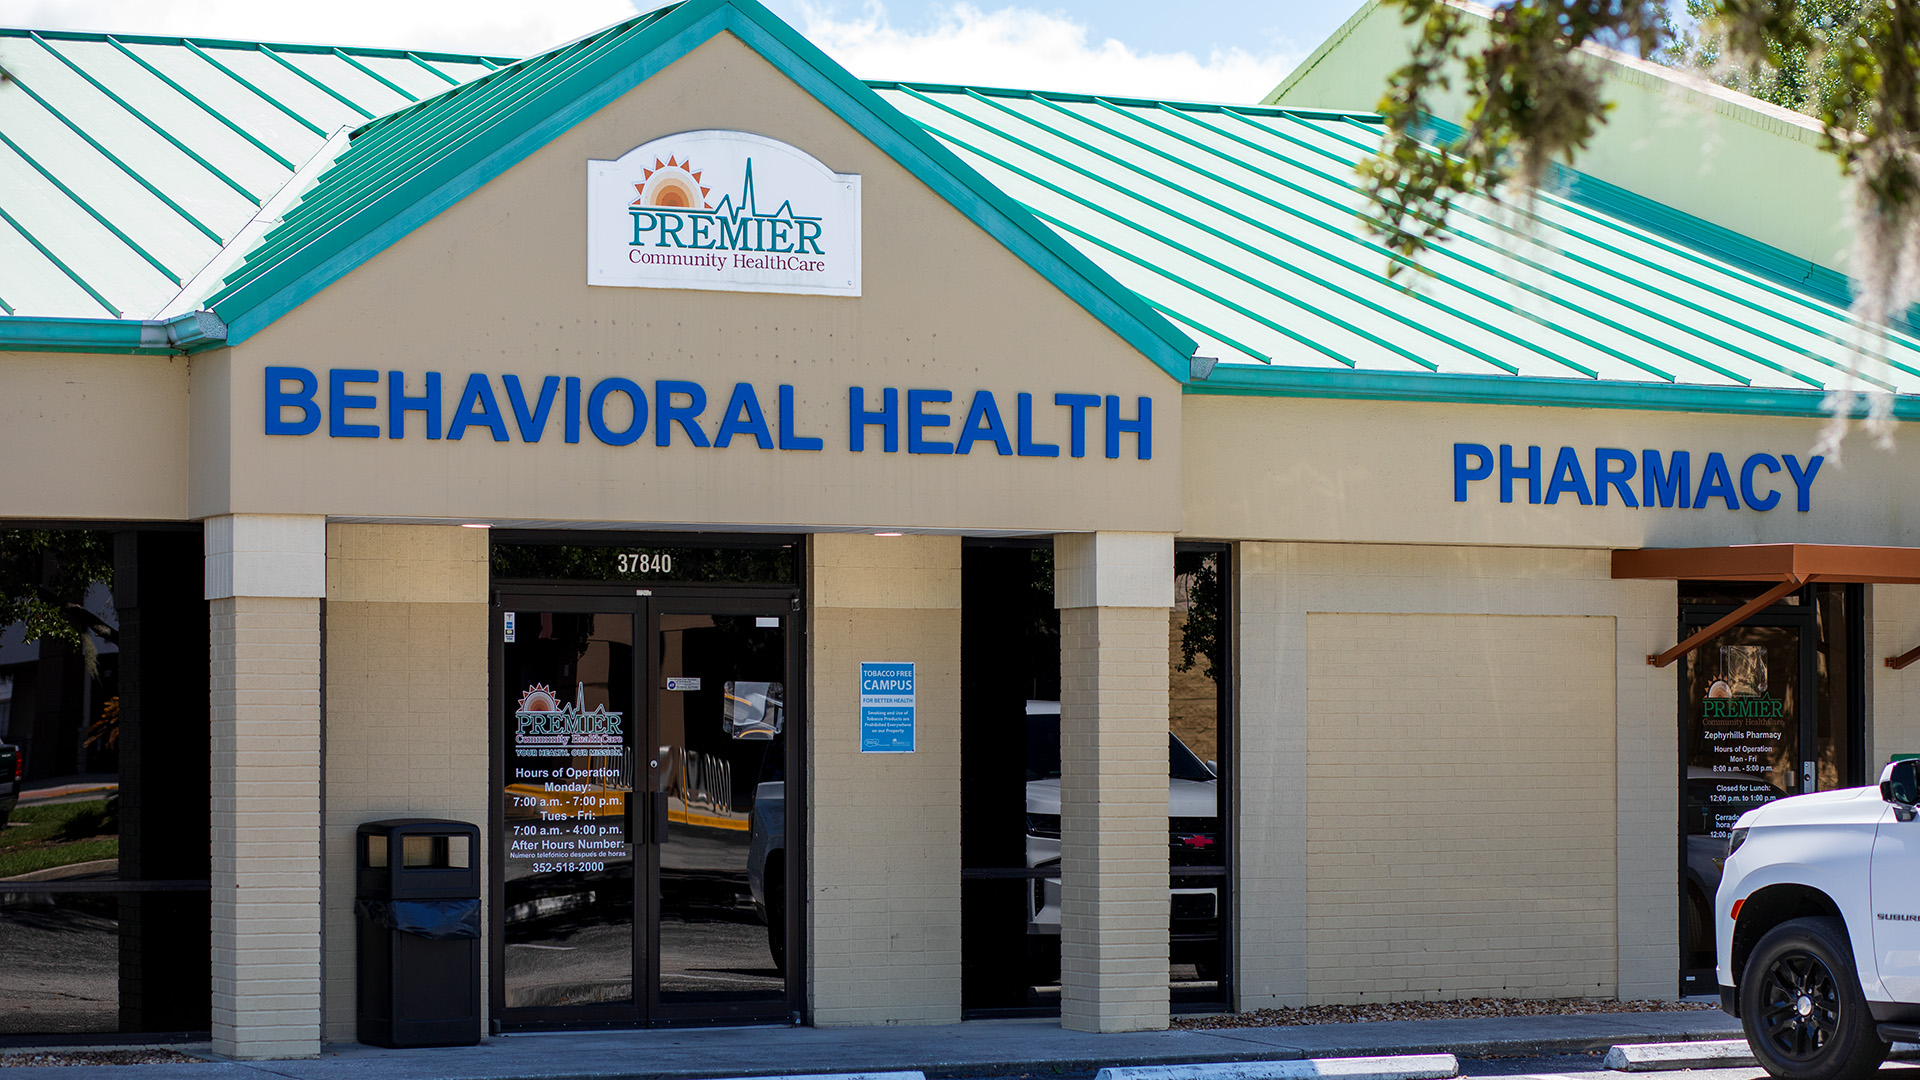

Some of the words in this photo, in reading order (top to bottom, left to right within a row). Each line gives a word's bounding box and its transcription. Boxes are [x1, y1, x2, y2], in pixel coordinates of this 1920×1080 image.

[629, 211, 825, 254] PREMIER
[629, 249, 727, 271] Community
[733, 254, 825, 272] HealthCare
[264, 366, 823, 450] BEHAVIORAL
[849, 386, 1152, 460] HEALTH
[1453, 443, 1825, 512] PHARMACY
[617, 554, 672, 573] 37840
[864, 680, 912, 690] CAMPUS
[1702, 701, 1783, 718] PREMIER
[515, 714, 623, 734] PREMIER
[1702, 718, 1743, 727] Community
[1746, 718, 1784, 726] HealthCare
[515, 735, 570, 746] Community
[572, 735, 623, 743] HealthCare
[1704, 731, 1744, 740] Zephyrhills
[1746, 731, 1782, 740] Pharmacy
[1742, 745, 1772, 754] Operation
[516, 768, 549, 778] Hours
[552, 768, 563, 777] of
[566, 768, 620, 779] Operation
[544, 783, 592, 793] Monday:
[514, 797, 536, 806] 7:00
[540, 798, 562, 806] a.m.
[573, 797, 596, 806] 7:00
[599, 797, 622, 808] p.m.
[540, 811, 567, 821] Tues
[577, 811, 596, 820] Fri:
[514, 826, 536, 835] 7:00
[540, 827, 562, 835] a.m.
[573, 825, 596, 834] 4:00
[599, 826, 622, 837] p.m.
[511, 840, 539, 850] After
[542, 840, 574, 850] Hours
[578, 839, 624, 849] Number:
[532, 862, 604, 873] 352-518-2000
[1877, 913, 1920, 921] SUBUR
